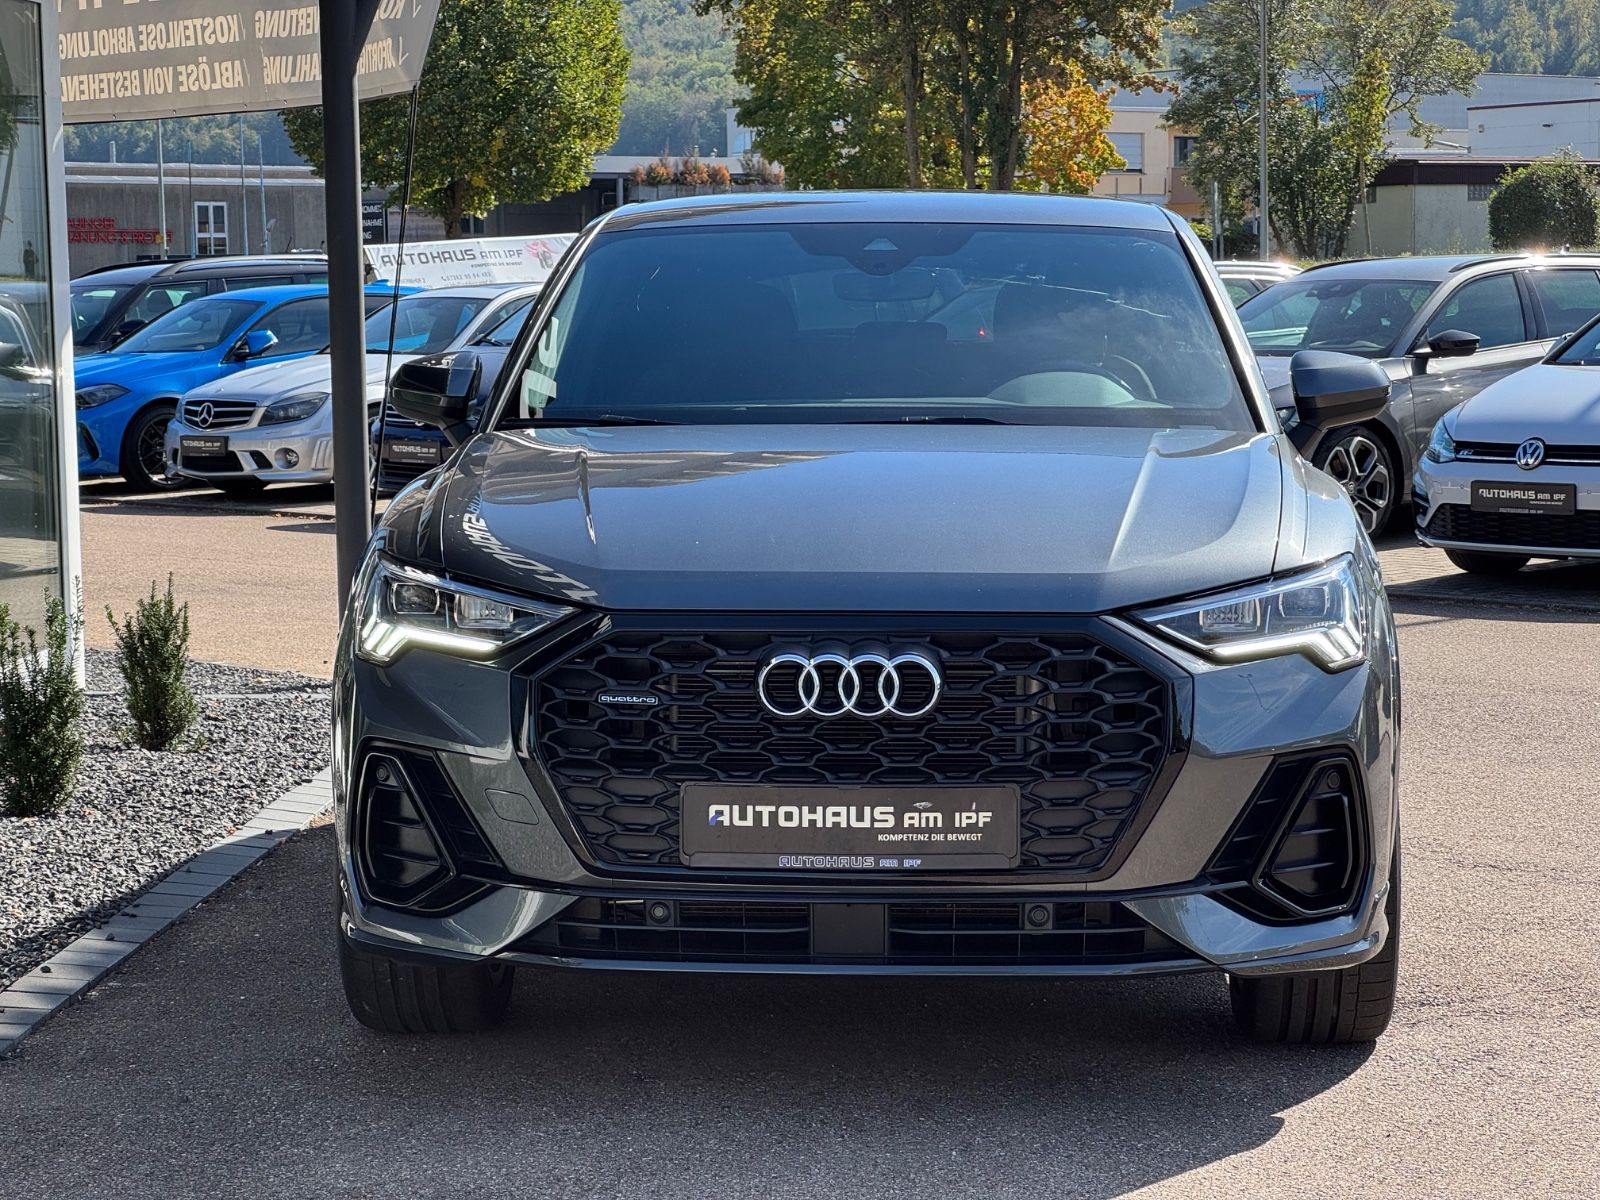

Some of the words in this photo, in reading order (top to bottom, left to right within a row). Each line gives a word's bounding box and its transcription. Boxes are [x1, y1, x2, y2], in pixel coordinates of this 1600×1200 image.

[381, 248, 476, 267] AUTOHAUS
[480, 250, 502, 260] AM
[504, 249, 523, 259] IPF
[1479, 488, 1535, 500] AUTOHAUS
[601, 695, 655, 703] quattro
[708, 804, 895, 828] AUTOHAUS
[903, 811, 943, 828] AM
[954, 811, 993, 828] IPF
[878, 833, 929, 842] KOMPETENZ
[931, 833, 946, 842] DIE
[947, 833, 982, 842] BEWEGT
[778, 855, 875, 868] AUTOHAUS
[879, 859, 898, 868] AM
[903, 859, 922, 868] IPF
